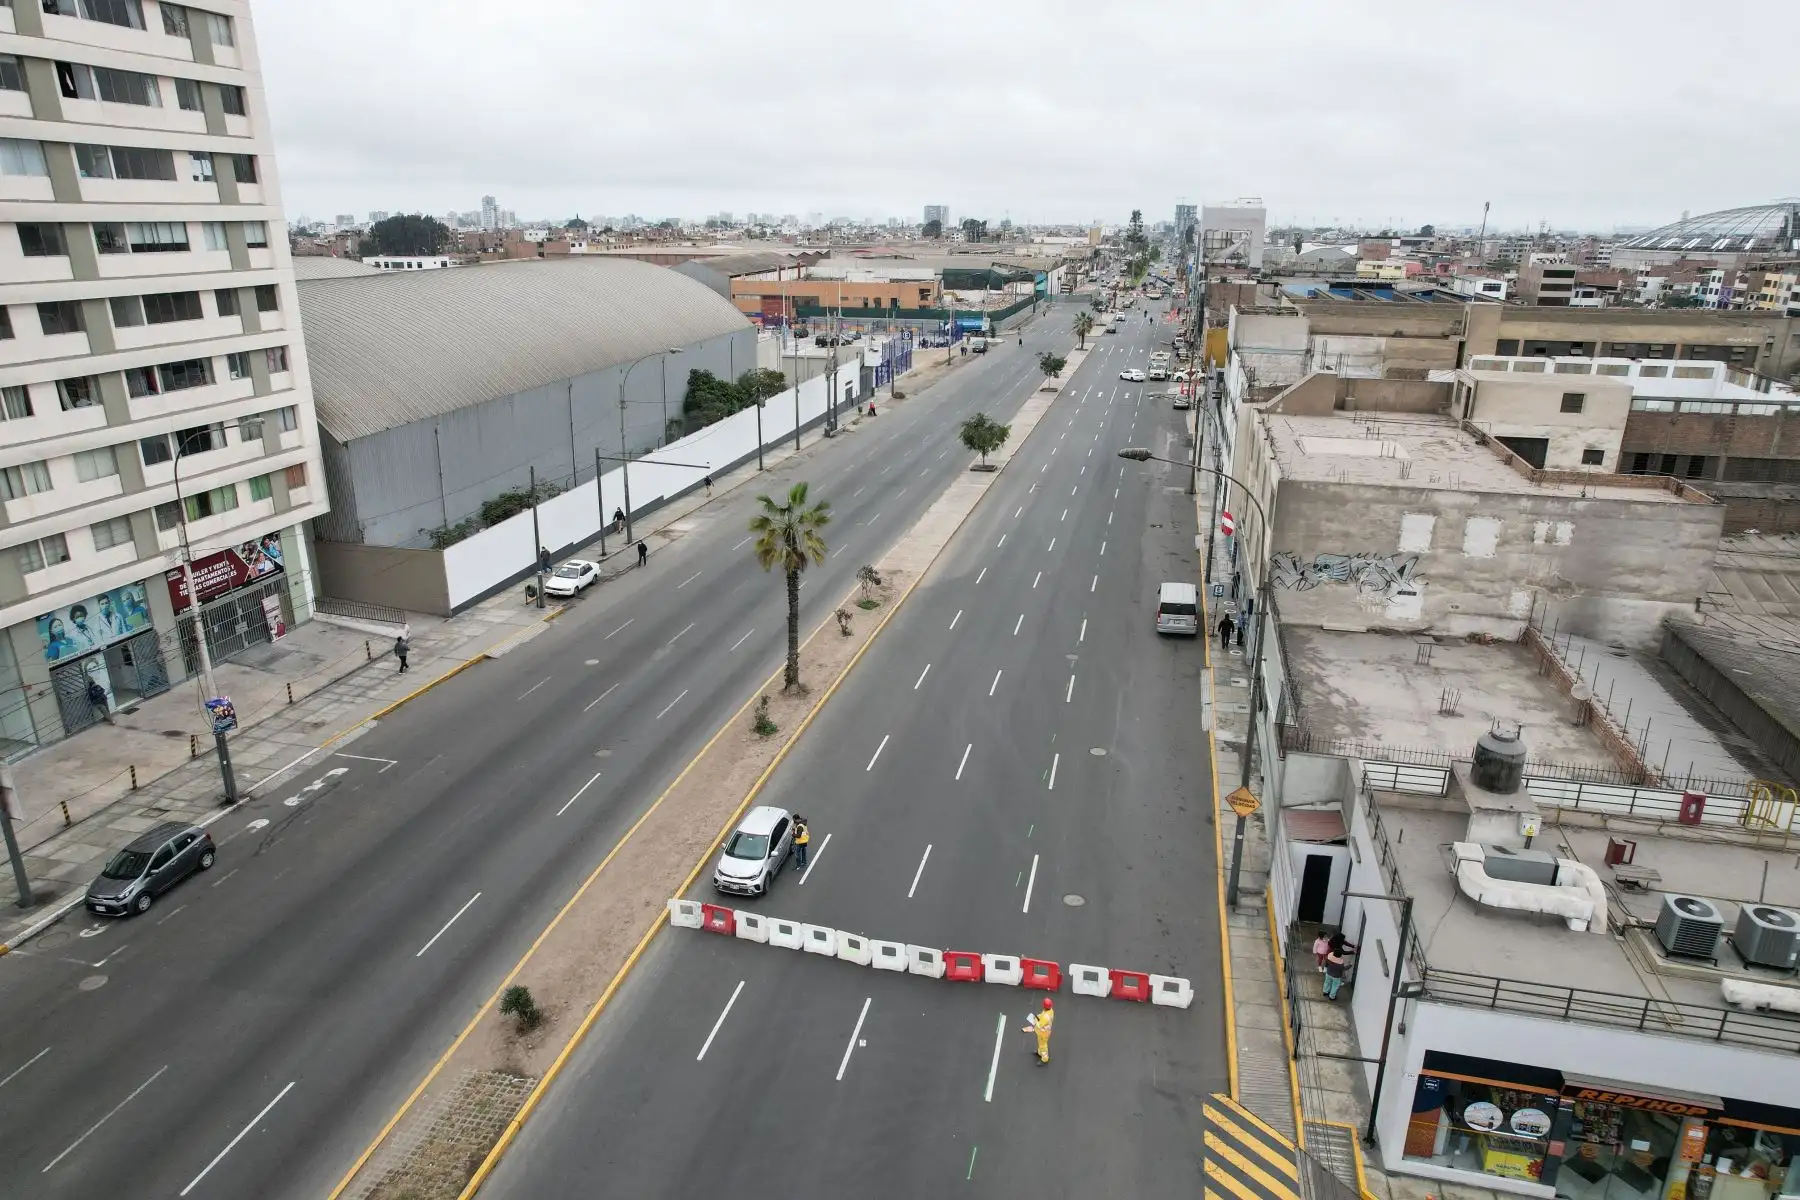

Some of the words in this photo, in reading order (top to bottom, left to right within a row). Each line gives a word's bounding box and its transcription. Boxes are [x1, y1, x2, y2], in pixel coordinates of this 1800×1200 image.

[183, 568, 209, 582] AUILER
[192, 567, 231, 584] PARTAMENTOS
[179, 584, 203, 597] TIEAS
